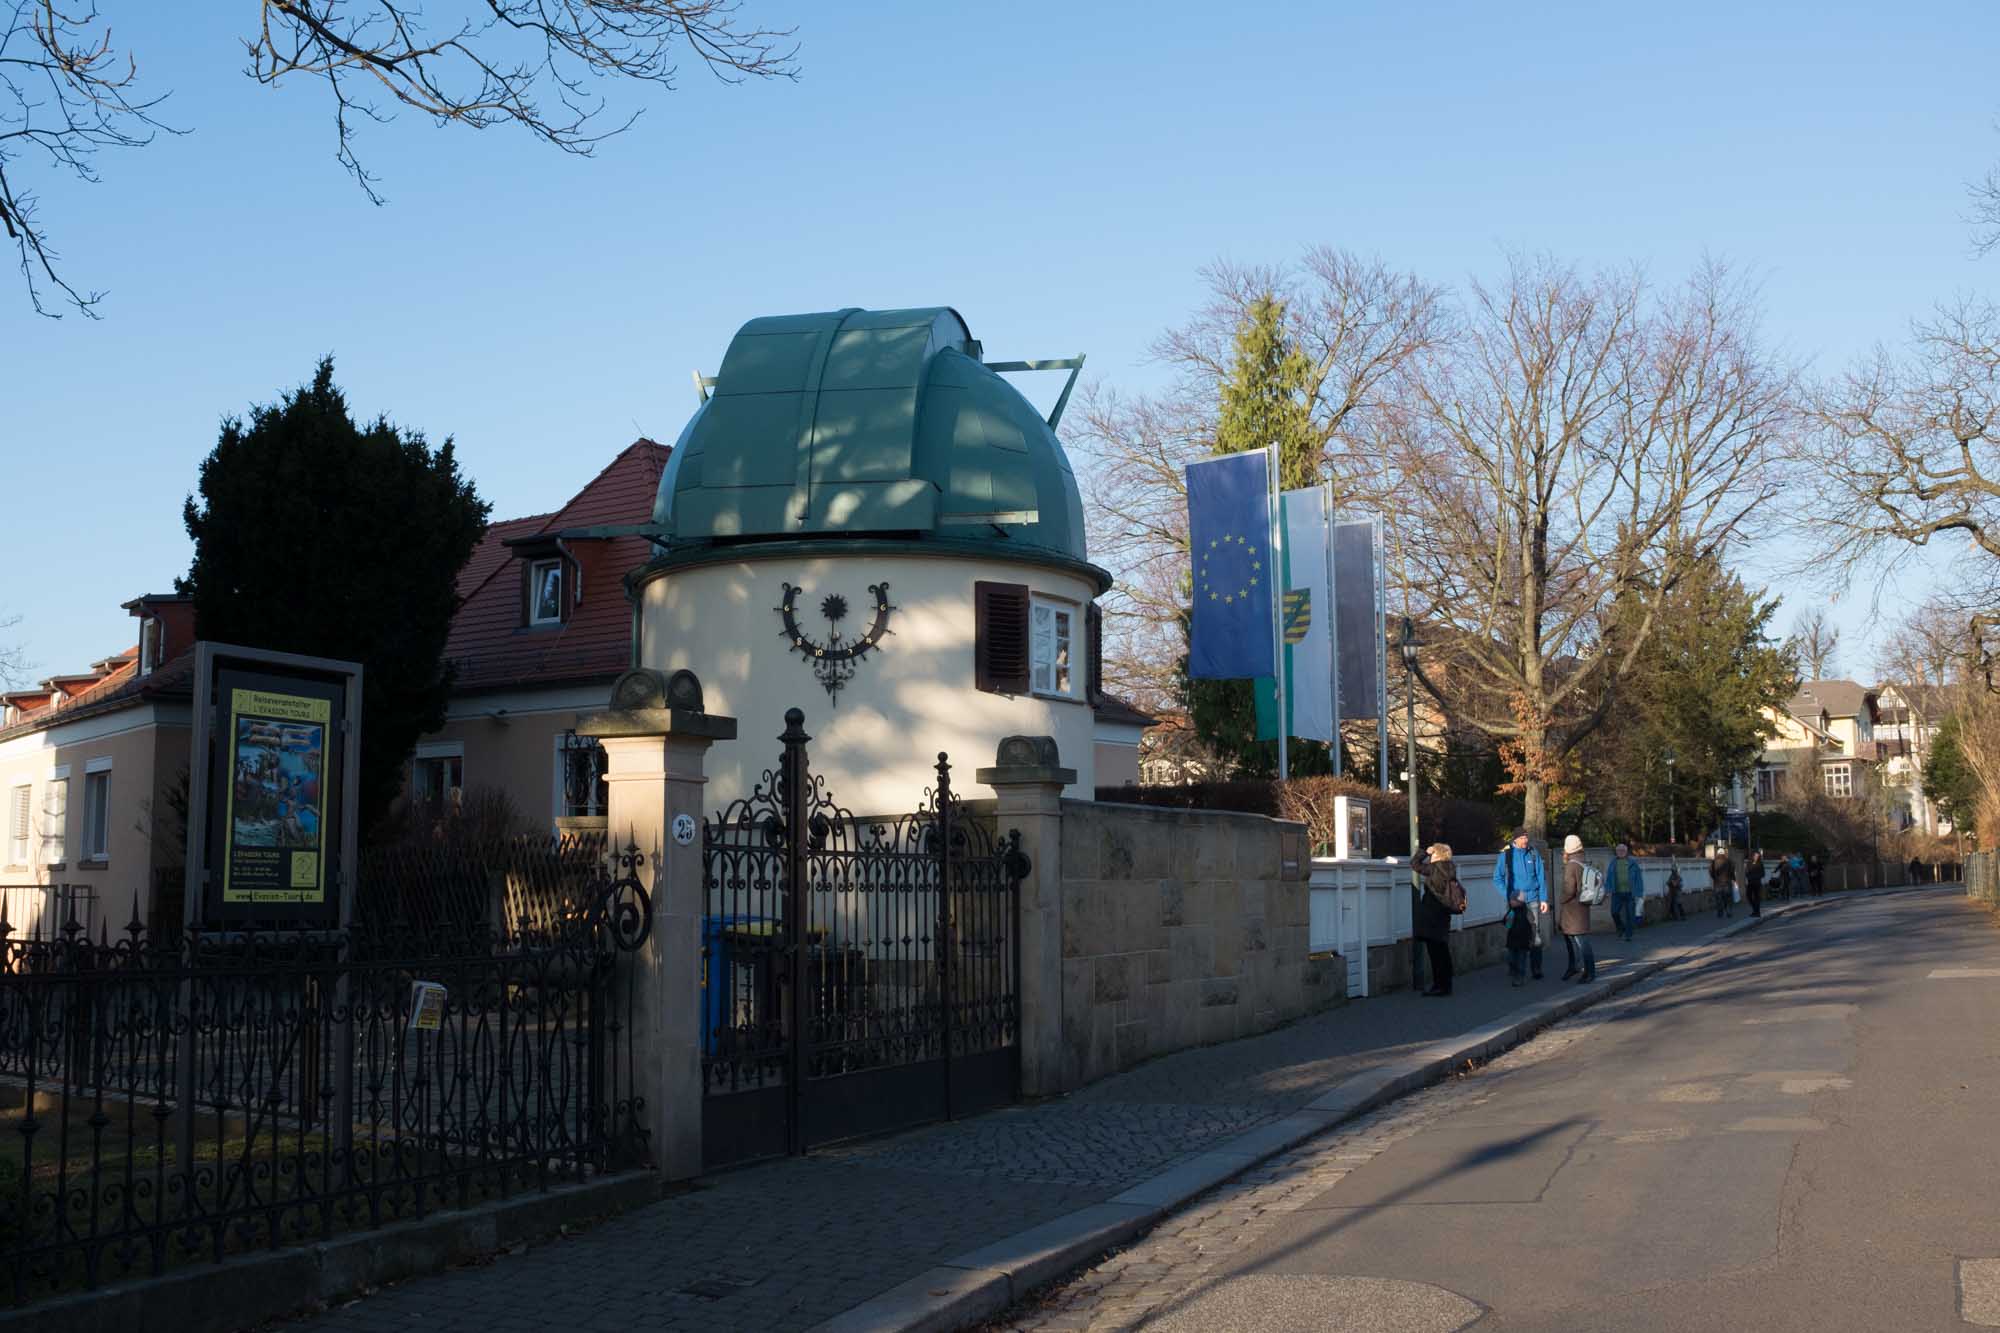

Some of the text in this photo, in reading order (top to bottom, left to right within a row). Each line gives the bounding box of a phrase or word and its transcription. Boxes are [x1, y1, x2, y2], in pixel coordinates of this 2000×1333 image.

[784, 604, 790, 612] 6
[880, 603, 886, 611] 6
[796, 637, 802, 646] 8
[815, 649, 824, 657] 10
[677, 819, 693, 840] 25
